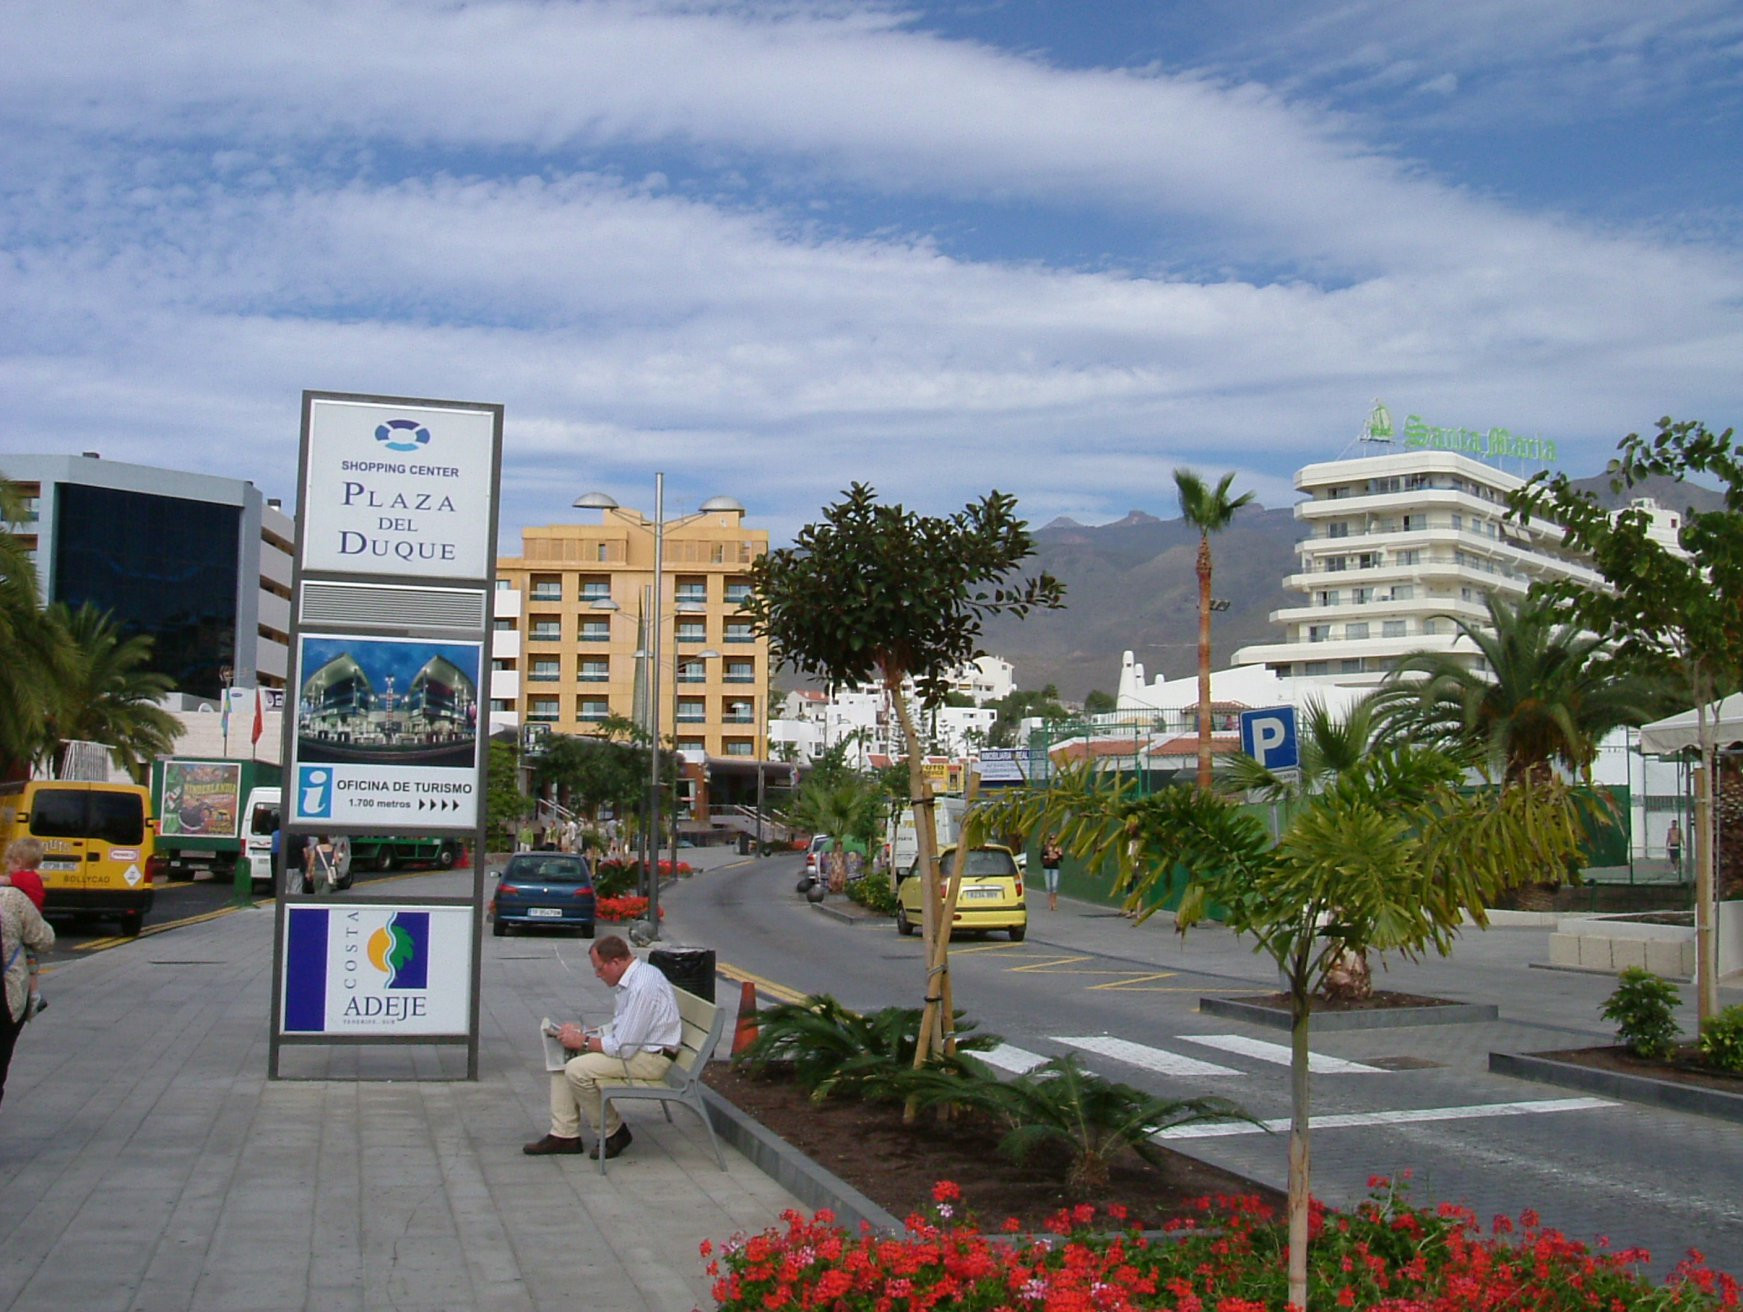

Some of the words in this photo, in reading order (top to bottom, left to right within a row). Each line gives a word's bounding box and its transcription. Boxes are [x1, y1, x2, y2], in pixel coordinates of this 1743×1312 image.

[1403, 414, 1480, 453] Santa
[341, 460, 406, 474] SHOPPING
[409, 465, 459, 477] CENTER
[341, 481, 456, 512] PLAZA
[378, 517, 418, 532] DEL
[337, 530, 456, 562] DUQUE
[1252, 717, 1285, 768] P
[337, 780, 390, 792] OFICINA
[393, 781, 411, 792] DE
[415, 782, 473, 794] TURISMO
[349, 799, 374, 808] 1.700
[376, 800, 411, 809] metros
[344, 911, 360, 990] COSTA
[343, 995, 427, 1022] ADEJE
